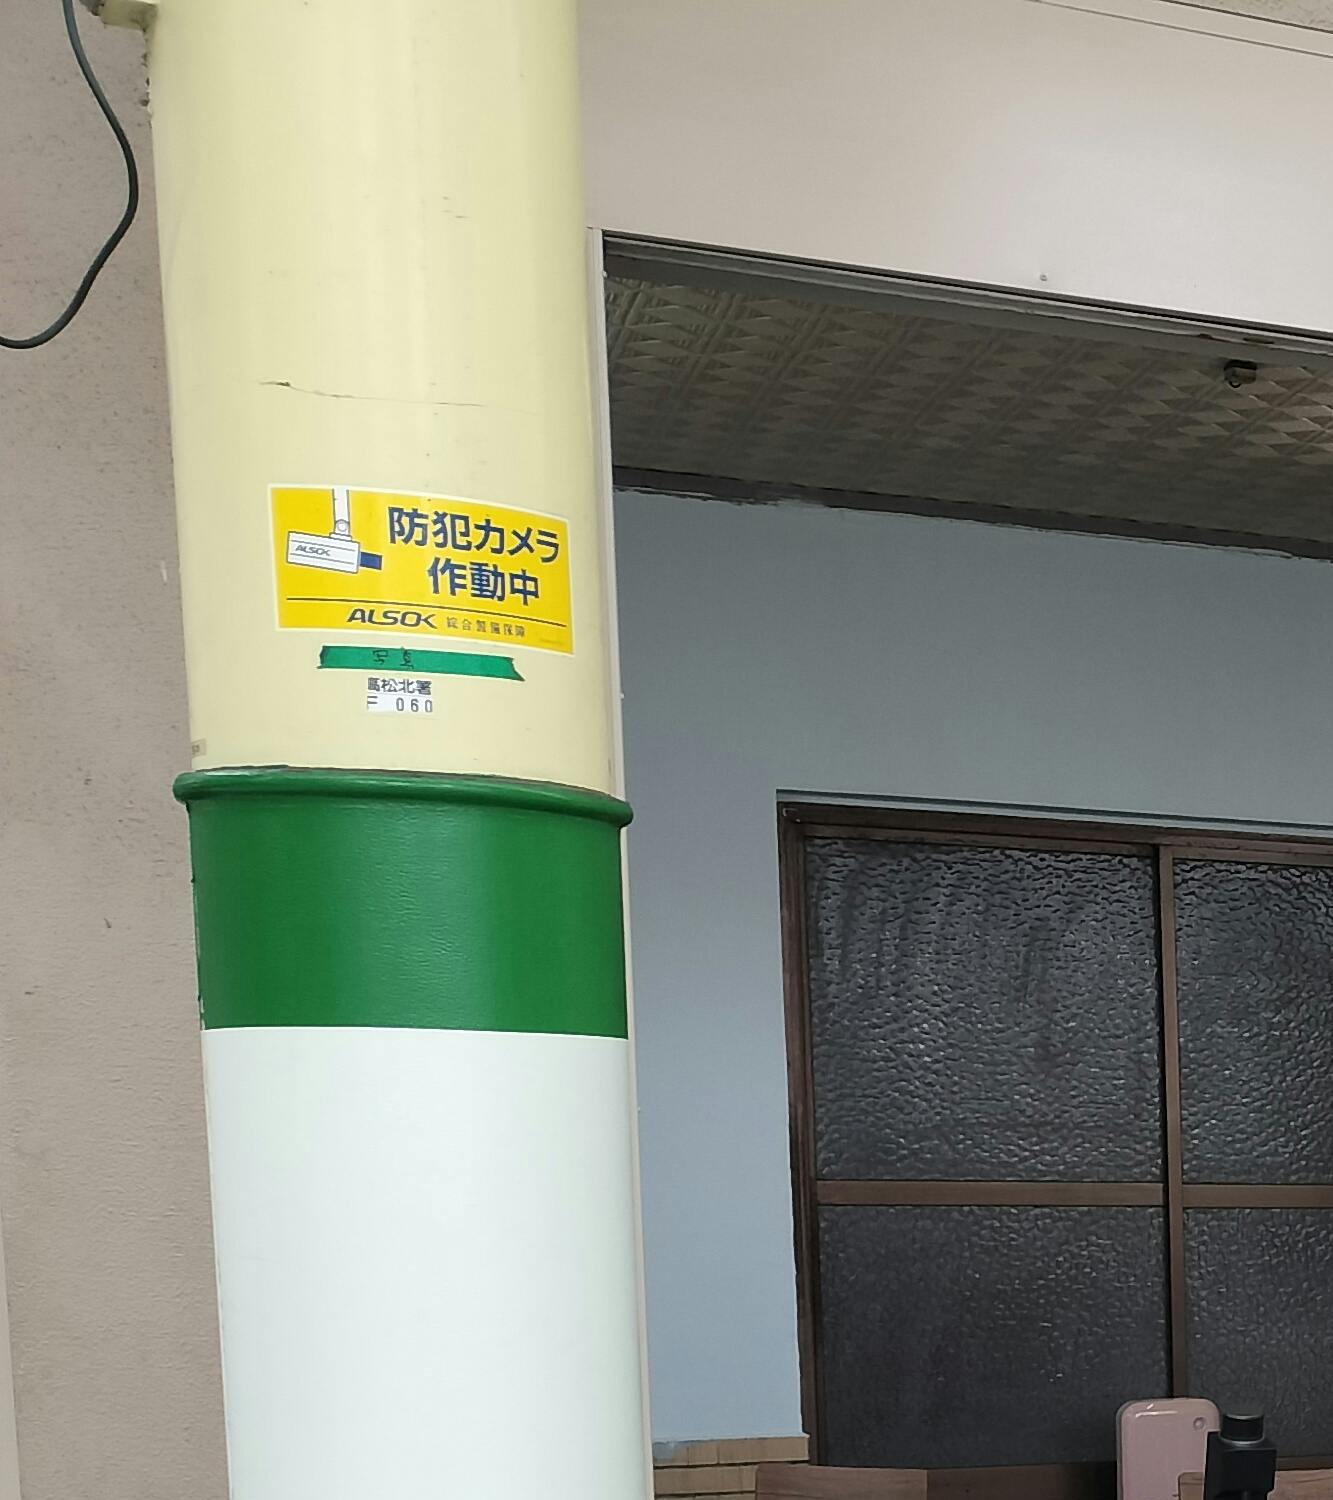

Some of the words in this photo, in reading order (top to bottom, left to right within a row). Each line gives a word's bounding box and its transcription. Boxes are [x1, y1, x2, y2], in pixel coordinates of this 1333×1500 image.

[388, 506, 560, 563] 防犯カメラ
[295, 544, 331, 557] ALSOK
[427, 557, 540, 606] 作動中
[346, 608, 438, 630] ALSOK
[396, 697, 433, 713] 060
